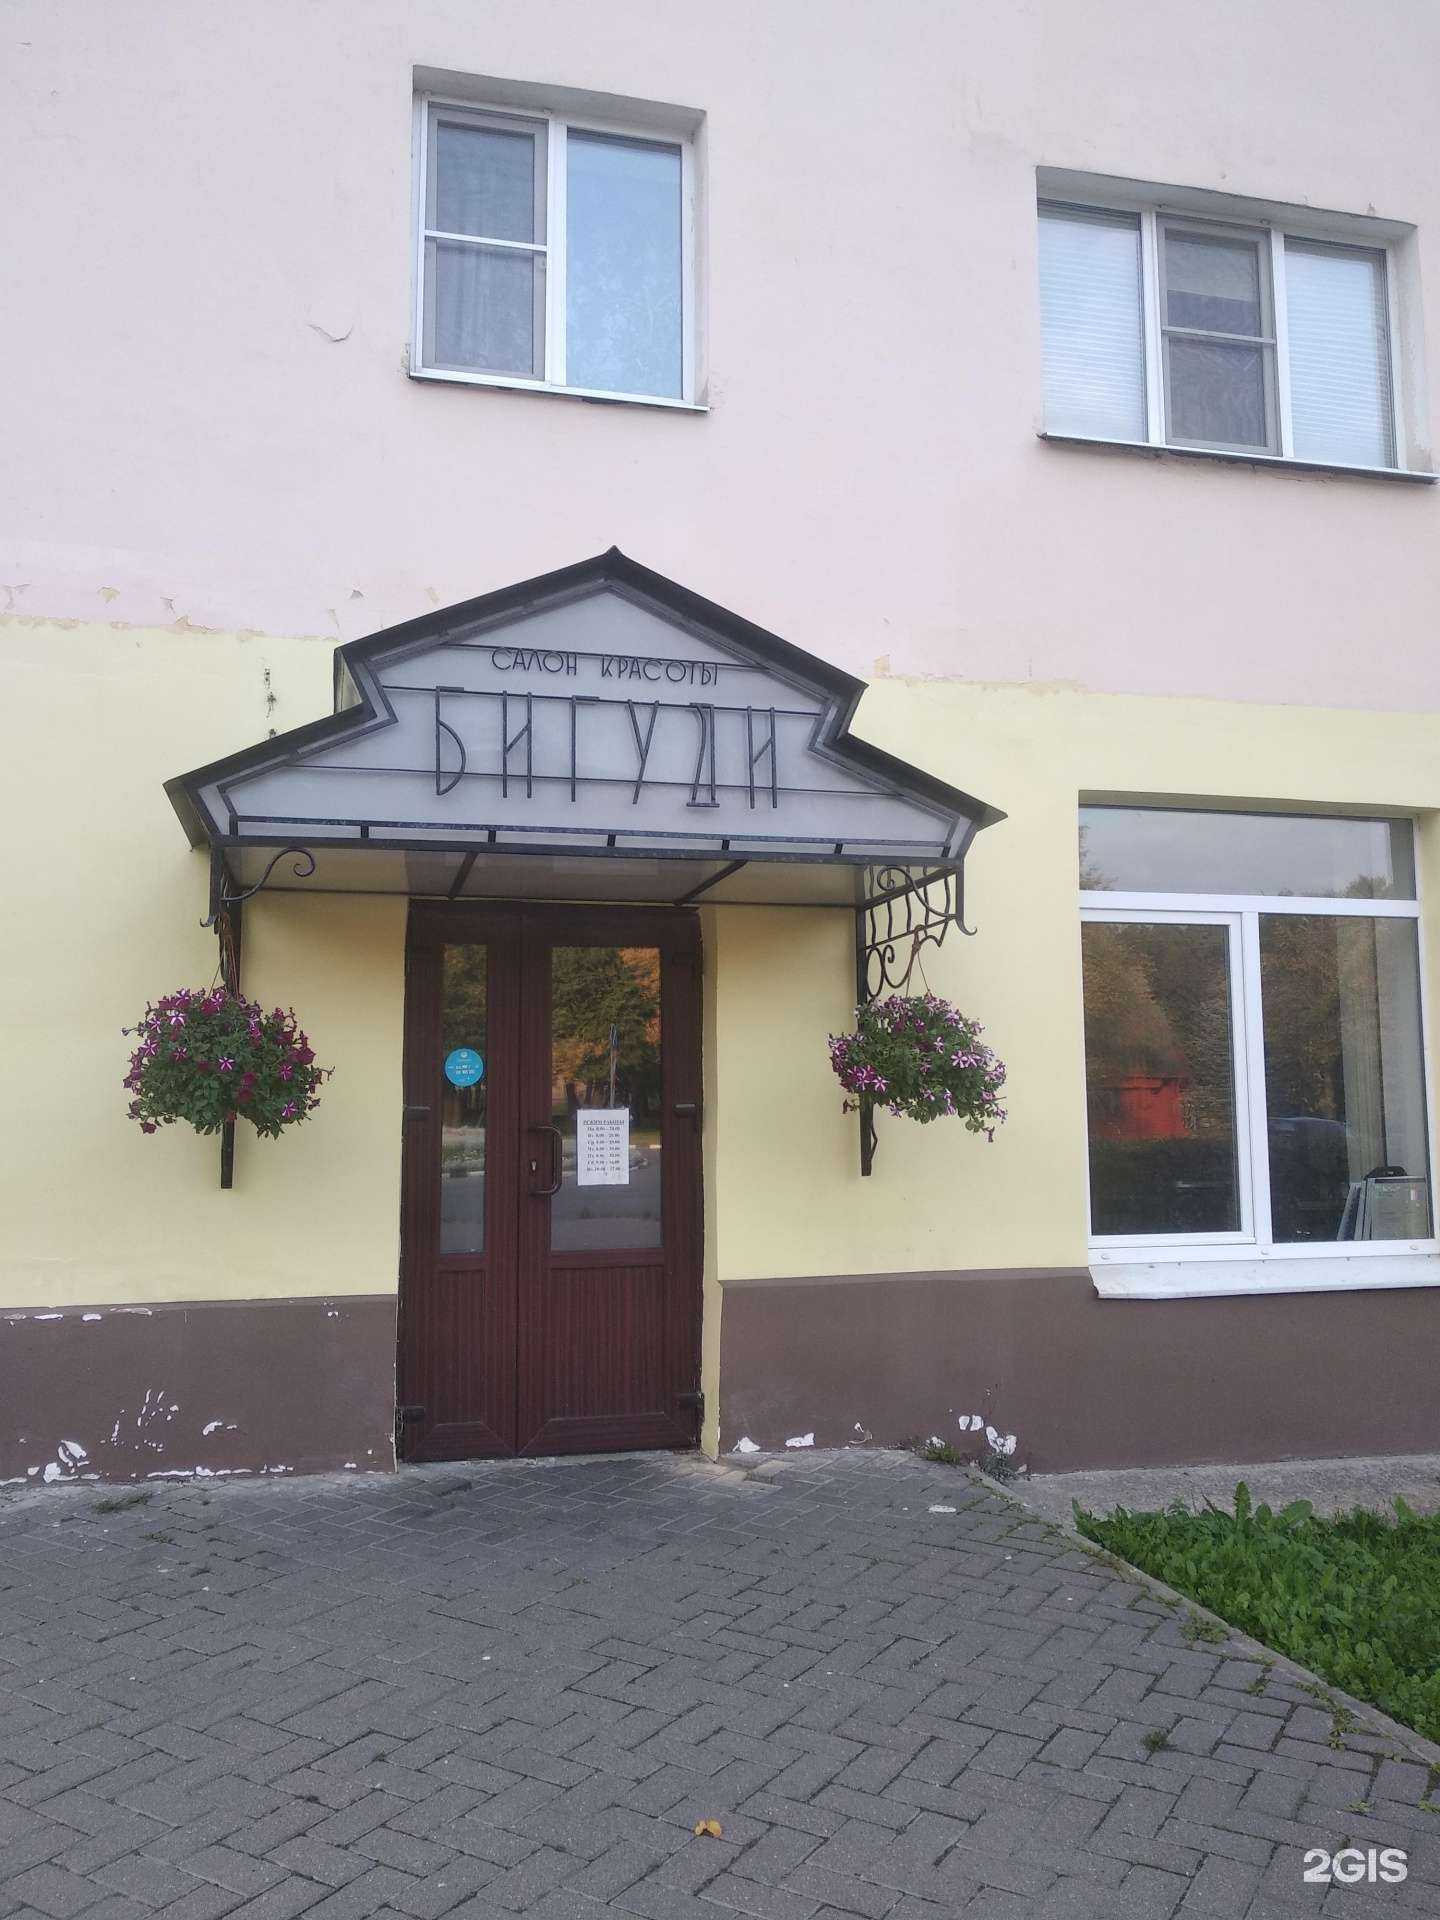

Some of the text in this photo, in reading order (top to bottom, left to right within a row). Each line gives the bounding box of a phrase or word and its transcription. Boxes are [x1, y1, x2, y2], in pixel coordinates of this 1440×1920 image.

[491, 647, 719, 686] САЛОН КРАСОТЫ
[435, 685, 778, 809] БИГУДИ
